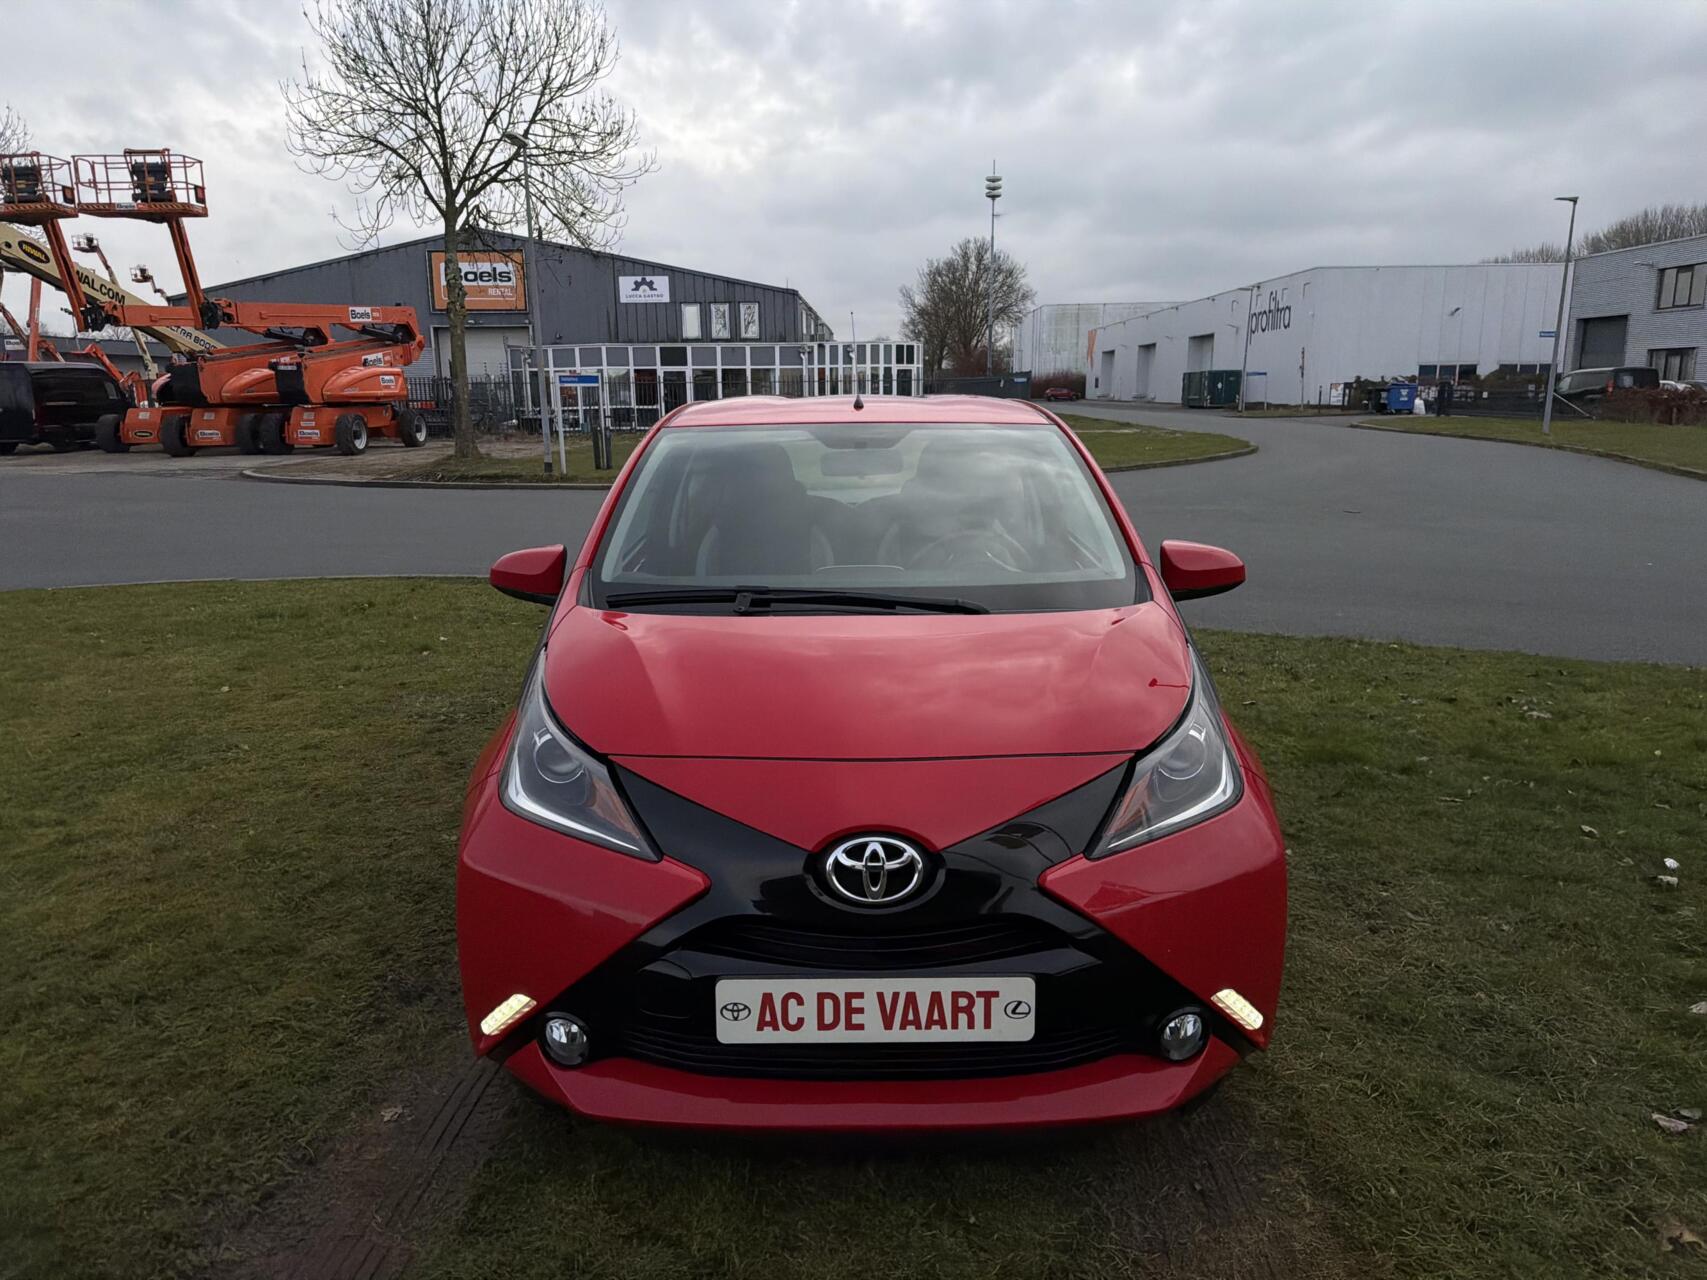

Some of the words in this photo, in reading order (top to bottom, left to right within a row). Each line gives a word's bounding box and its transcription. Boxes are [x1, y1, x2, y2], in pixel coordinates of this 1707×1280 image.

[445, 267, 512, 282] oels
[350, 309, 371, 320] Boels
[1250, 290, 1291, 344] profiltra
[756, 991, 805, 1032] AC
[816, 991, 865, 1031] DE
[876, 990, 1000, 1031] VAART
